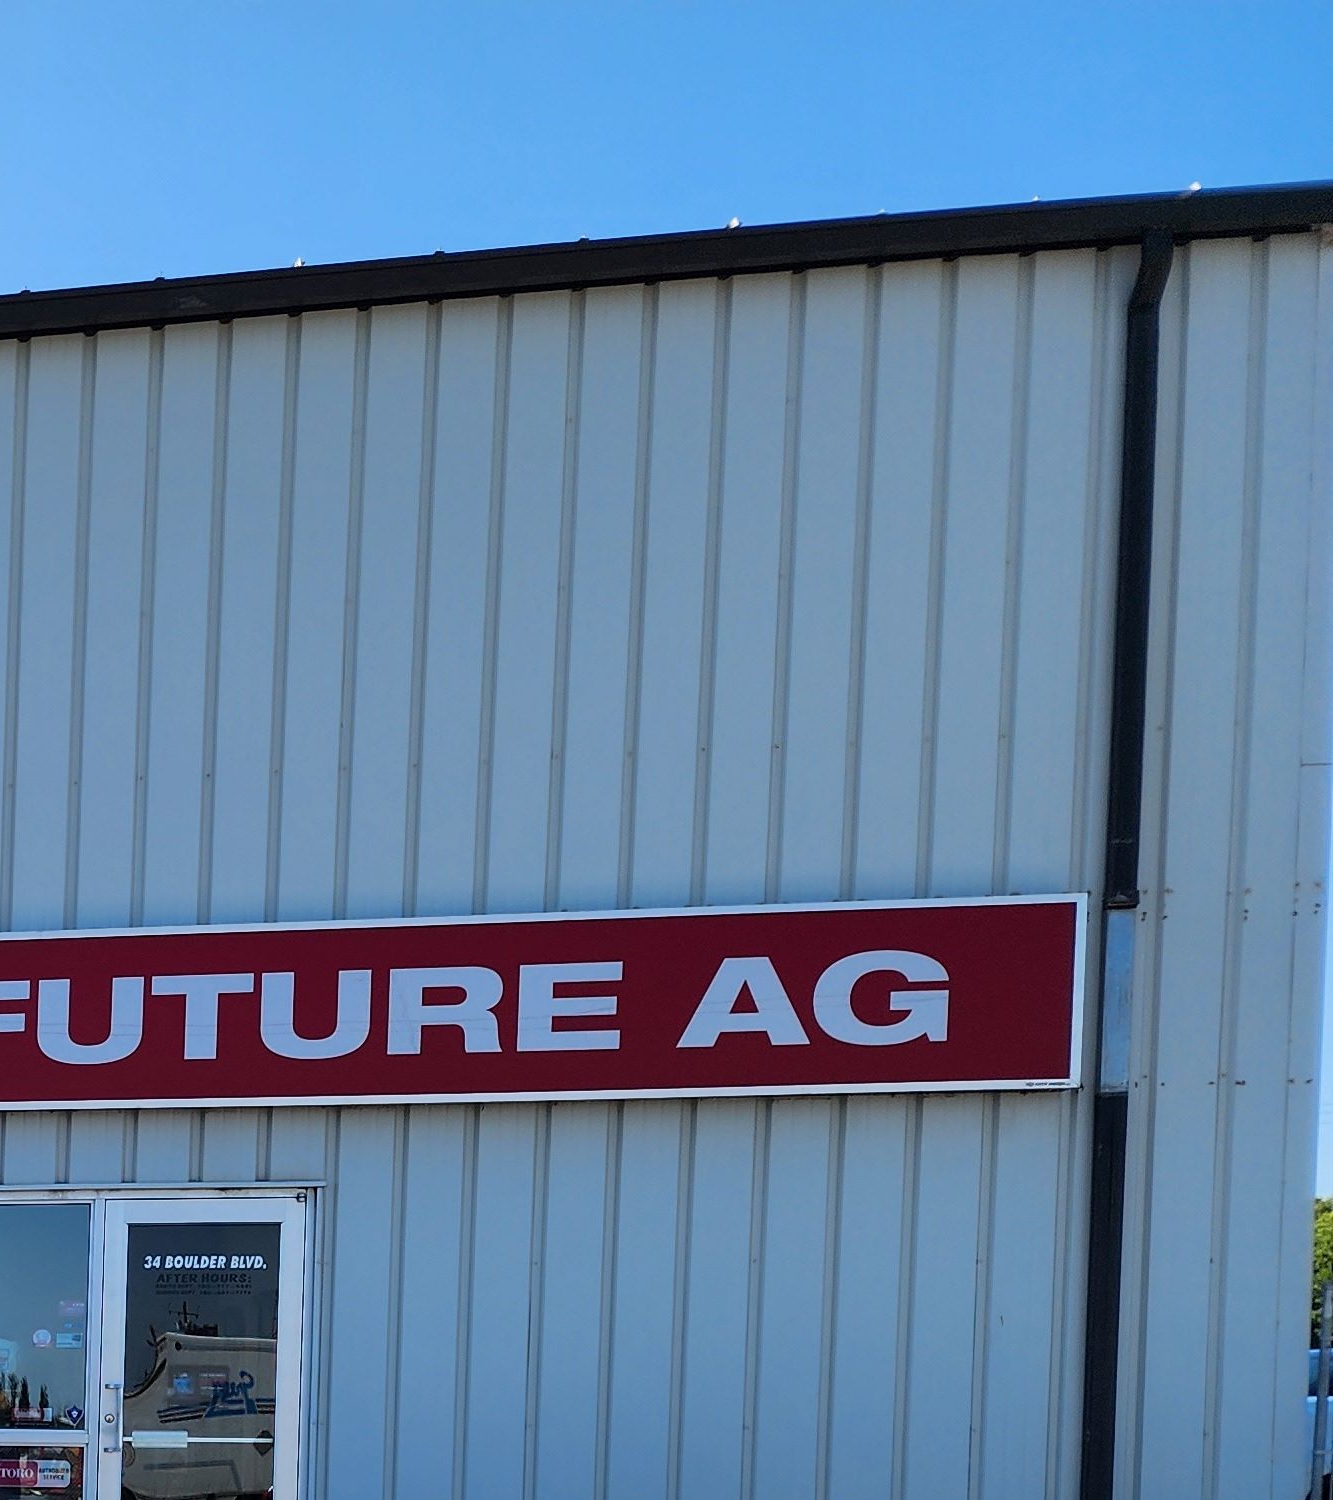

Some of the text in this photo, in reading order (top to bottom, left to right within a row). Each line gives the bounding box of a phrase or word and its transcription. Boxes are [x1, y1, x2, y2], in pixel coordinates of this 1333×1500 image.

[676, 949, 950, 1048] AG
[143, 1255, 267, 1270] 34 BOULDER BLVD.
[156, 1273, 252, 1283] AFTER HOURS:
